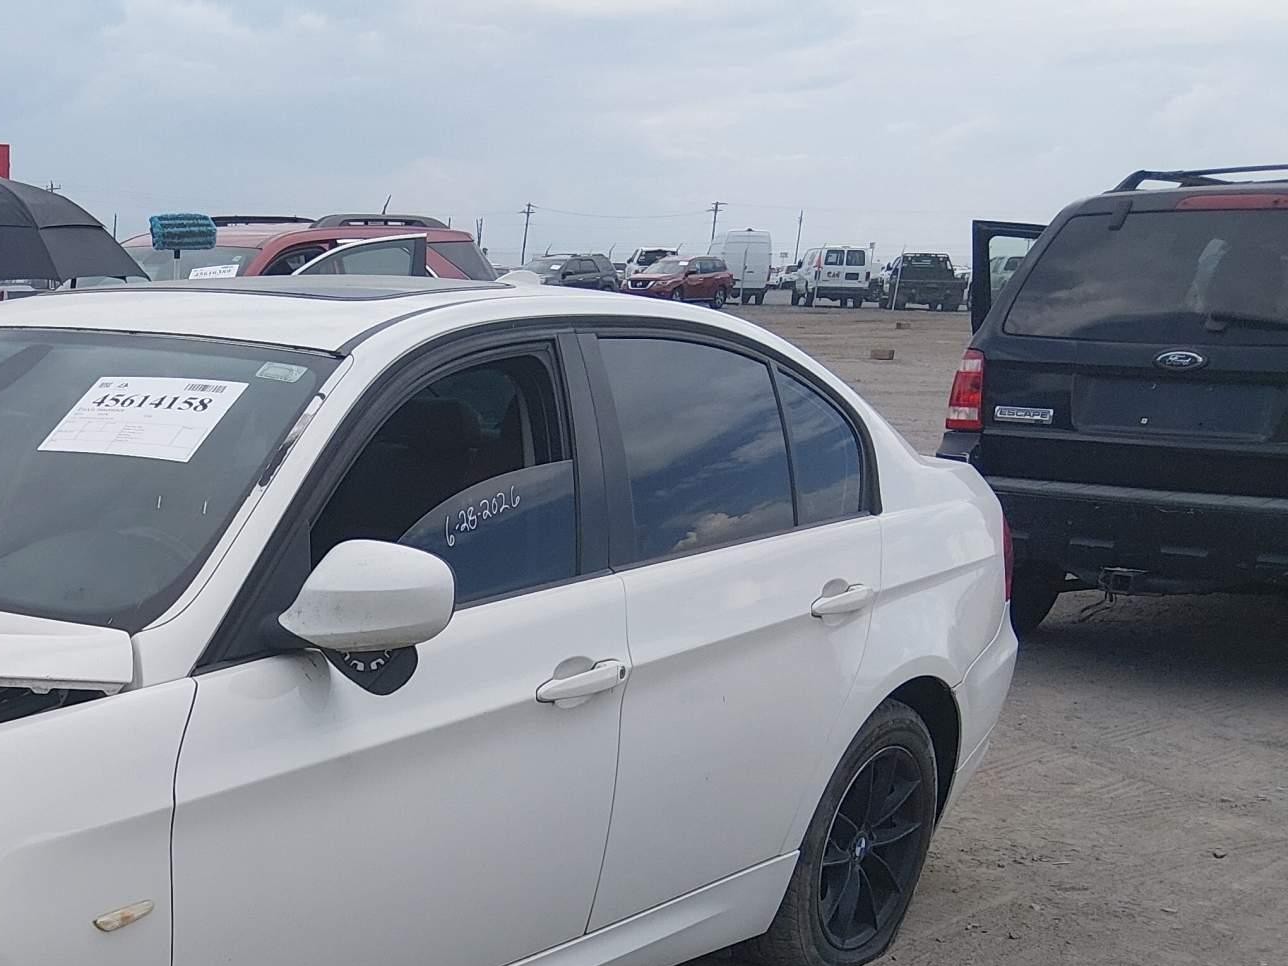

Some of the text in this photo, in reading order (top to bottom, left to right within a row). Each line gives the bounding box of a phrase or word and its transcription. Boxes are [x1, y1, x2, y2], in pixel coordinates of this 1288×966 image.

[93, 393, 213, 412] 45614158
[998, 407, 1051, 420] ESCAPE
[445, 485, 521, 547] 6-28-2026
